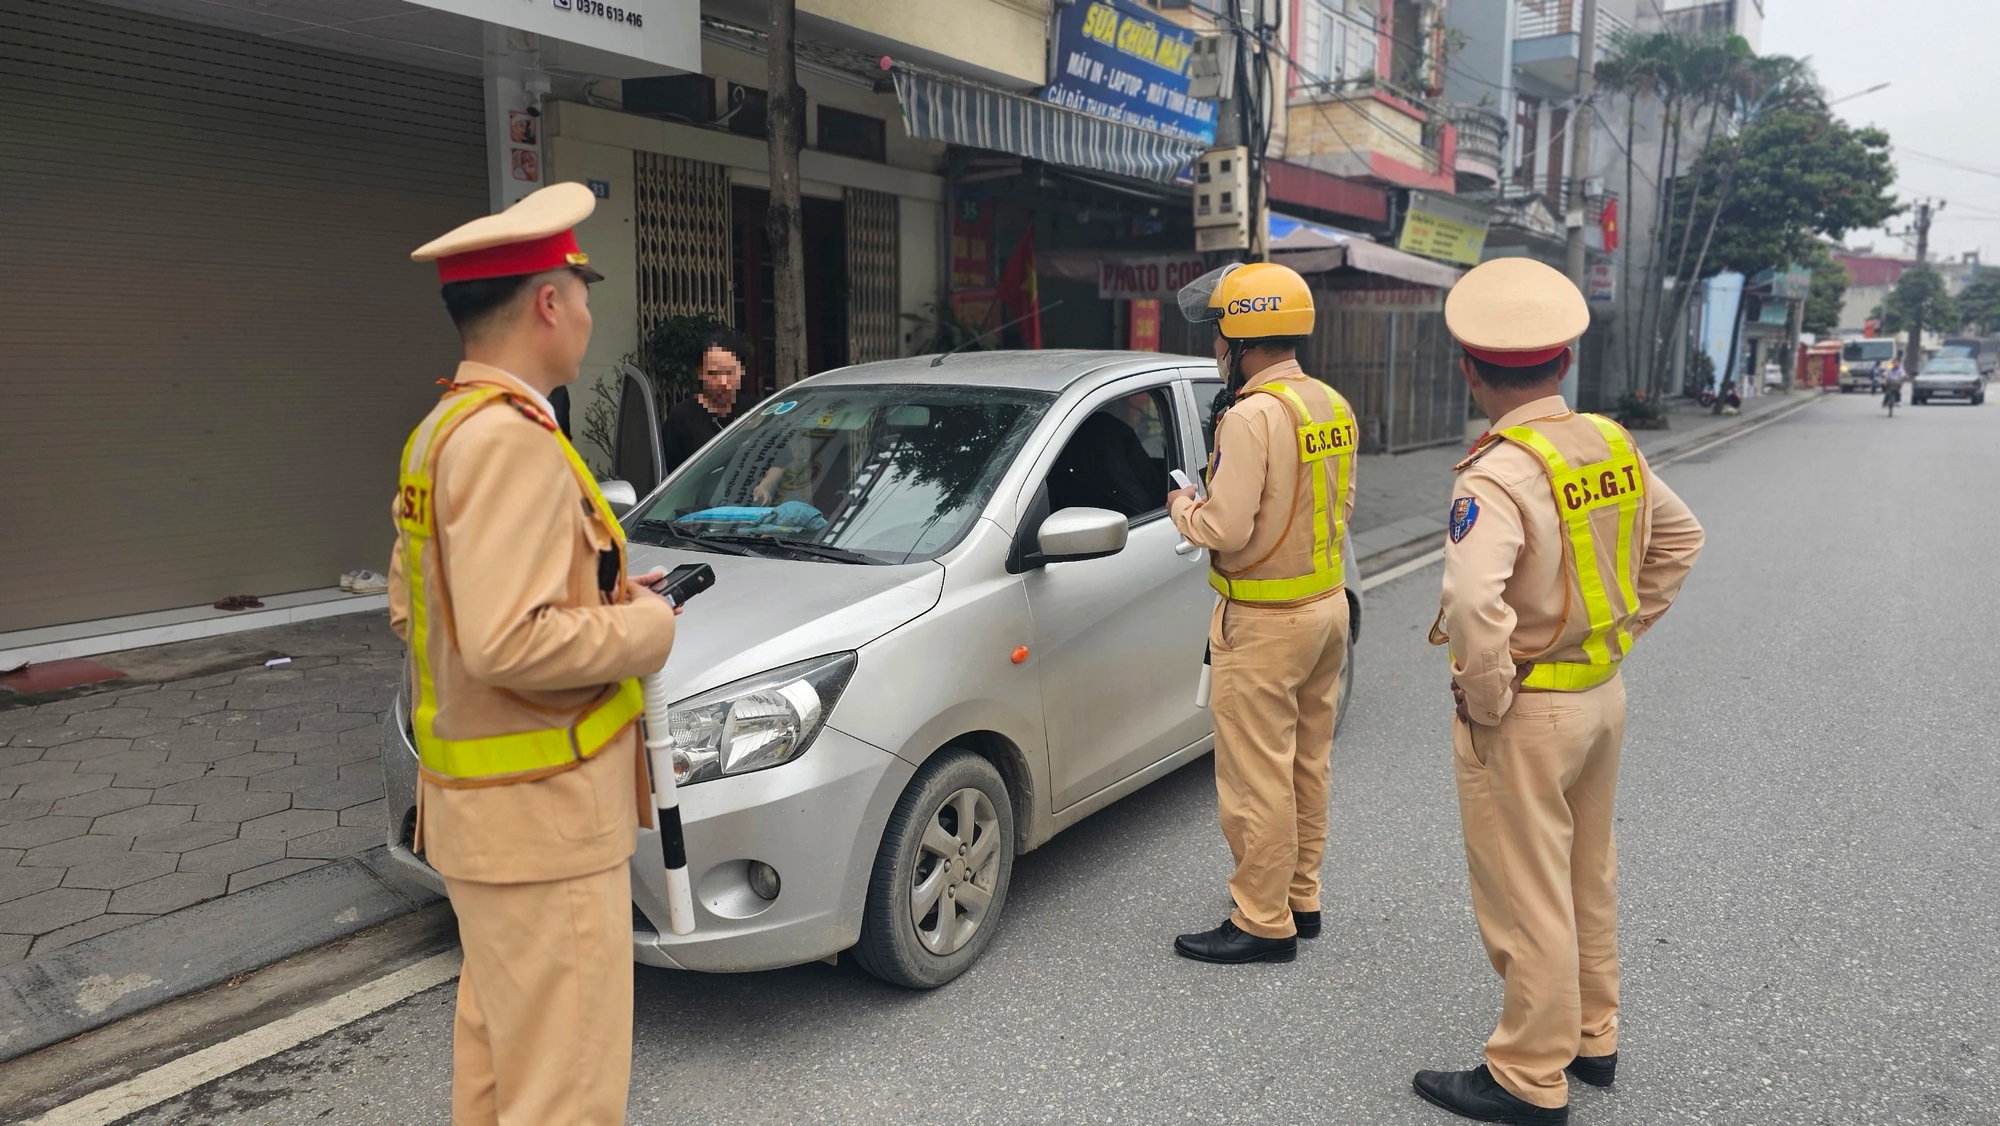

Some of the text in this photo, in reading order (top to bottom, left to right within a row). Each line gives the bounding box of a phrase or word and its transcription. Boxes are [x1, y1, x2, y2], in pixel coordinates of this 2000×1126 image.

[577, 0, 643, 28] 0378 613 416
[1156, 31, 1192, 76] MÁY
[1066, 51, 1092, 80] MÁY
[1089, 61, 1104, 84] IN
[1107, 67, 1143, 98] LAPTOP
[1146, 82, 1168, 107] MÁY
[1166, 87, 1187, 114] TÍNH
[1048, 82, 1067, 106] CÀI
[1086, 97, 1109, 116] THAY
[1108, 102, 1126, 120] THẾ
[592, 183, 605, 197] 33
[961, 200, 978, 220] 35
[1103, 263, 1159, 292] PHOTO
[1228, 296, 1282, 315] CSGT
[1305, 425, 1353, 454] C.S.G.T
